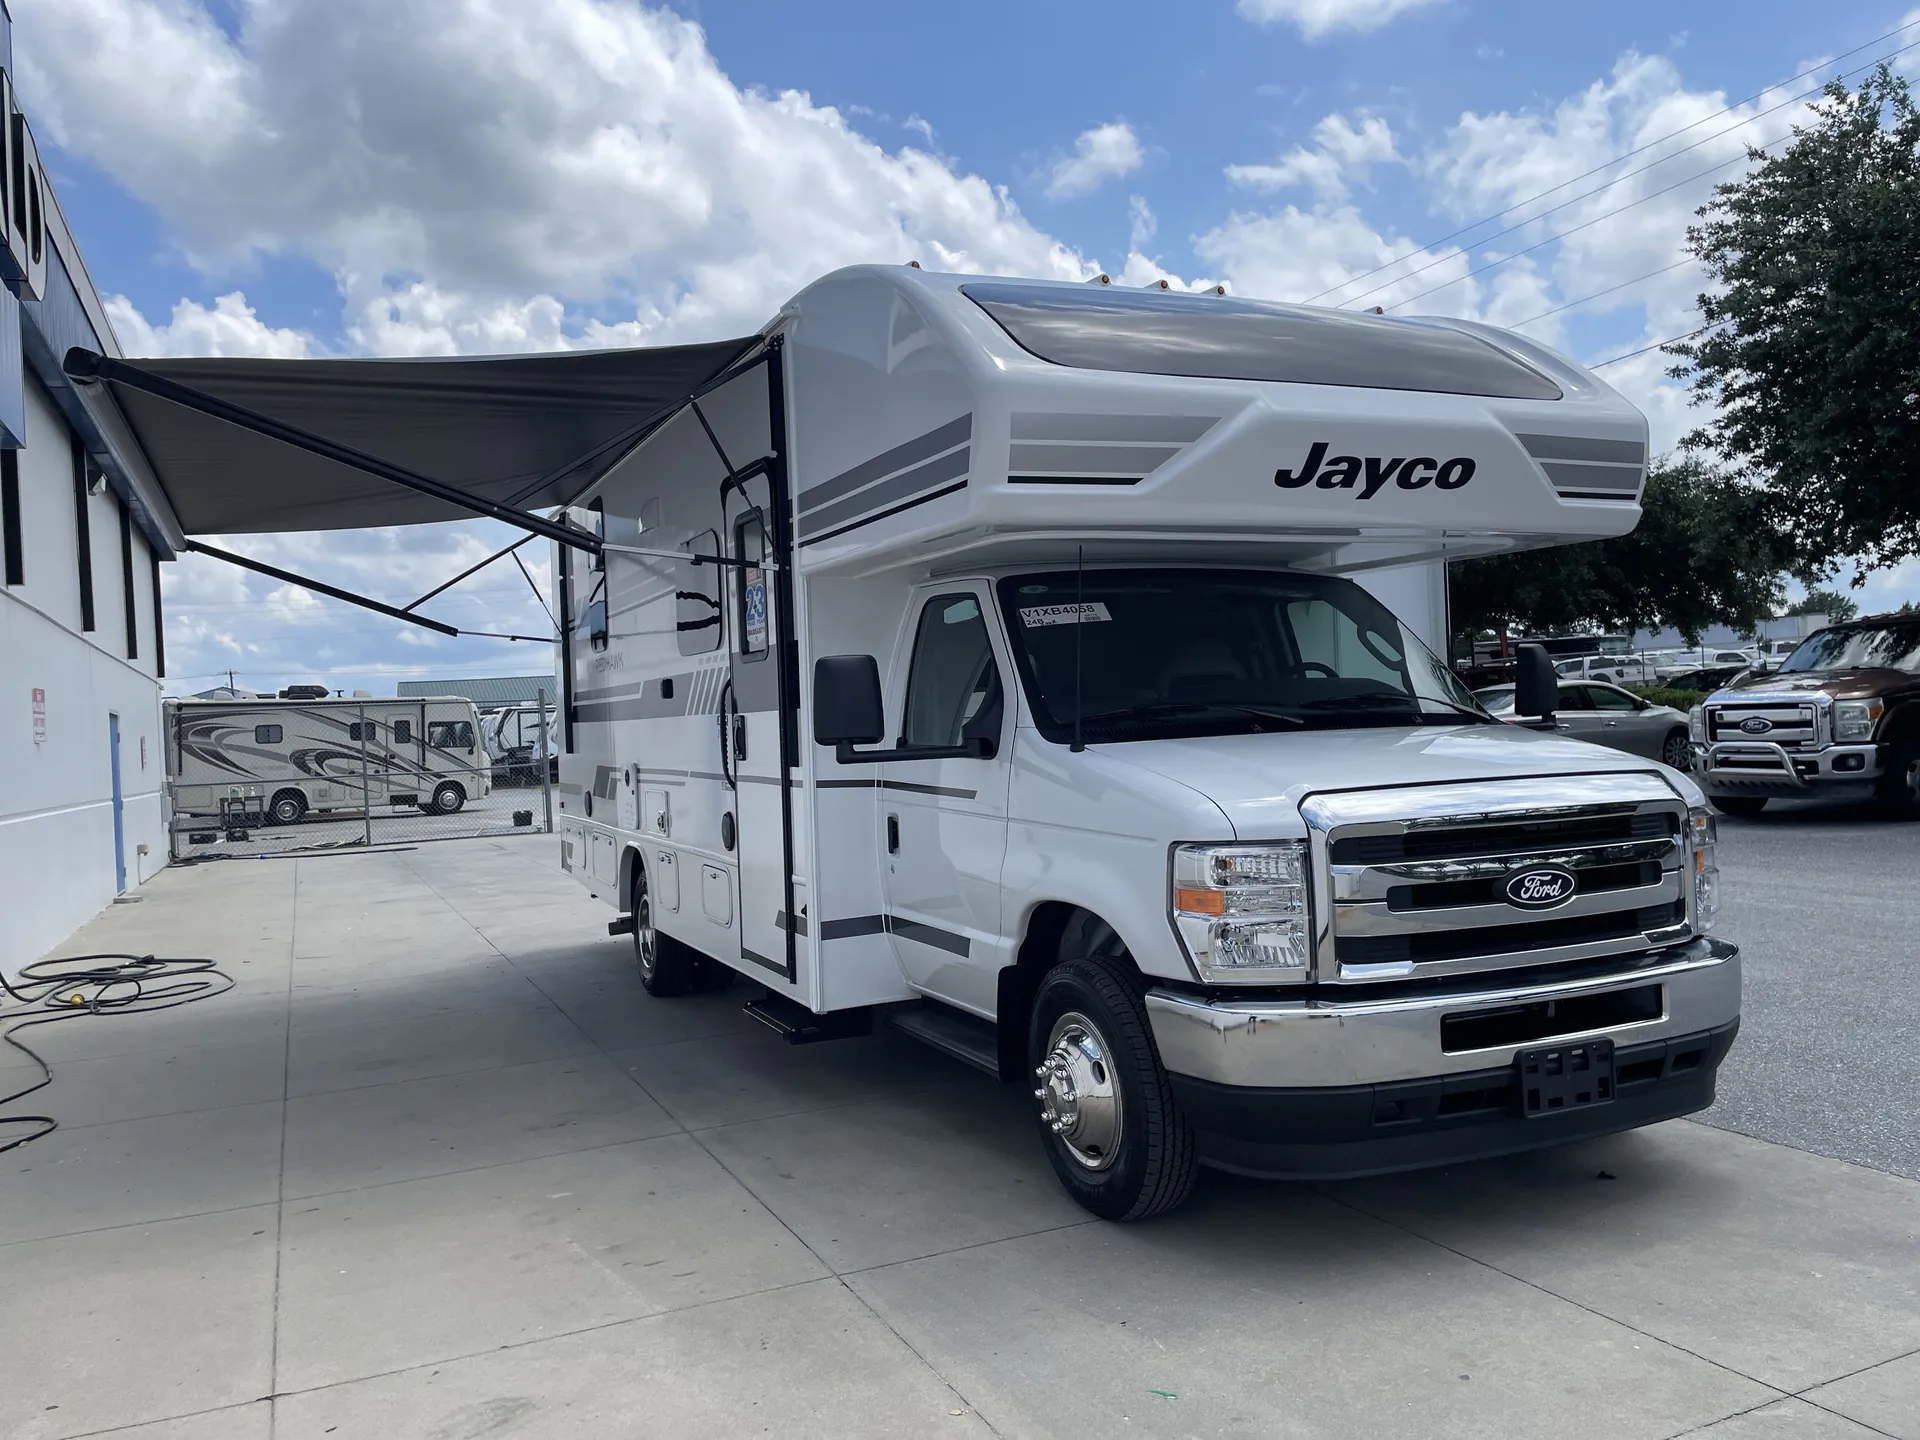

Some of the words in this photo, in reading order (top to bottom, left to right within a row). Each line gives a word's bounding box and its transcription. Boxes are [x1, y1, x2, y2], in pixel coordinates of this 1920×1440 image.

[1274, 442, 1476, 500] Jayco
[1021, 605, 1095, 618] V1XB4058
[1520, 874, 1563, 900] Ford
